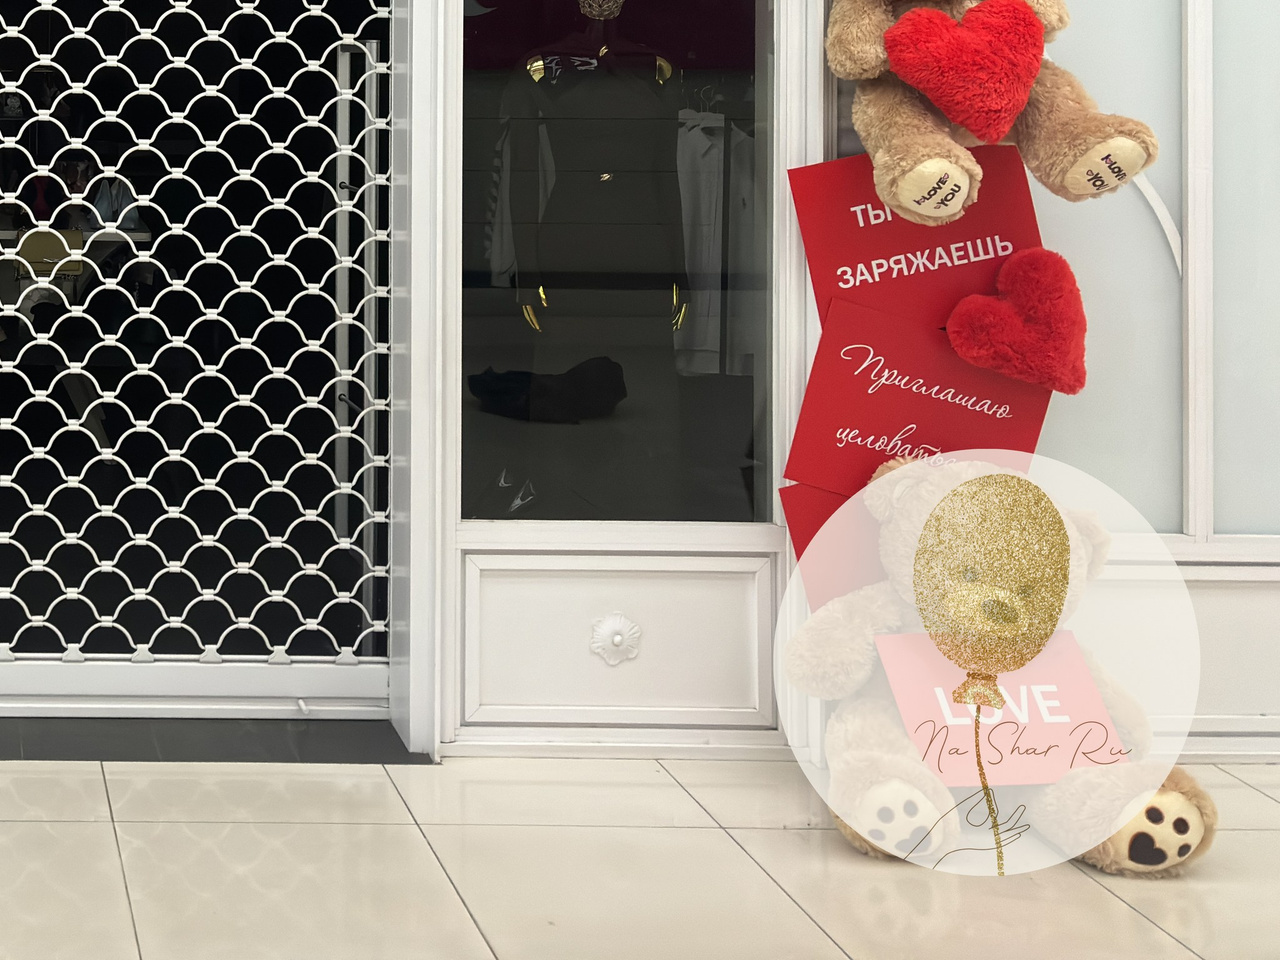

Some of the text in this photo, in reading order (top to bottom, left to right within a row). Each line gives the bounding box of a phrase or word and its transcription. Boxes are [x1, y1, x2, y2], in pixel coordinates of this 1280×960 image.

[922, 177, 948, 203] LOVE
[936, 183, 962, 208] YOU
[850, 202, 893, 228] ТЫ
[836, 234, 1014, 289] ЗАРЯЖАЕШЬ
[840, 343, 1013, 419] Приглашаю
